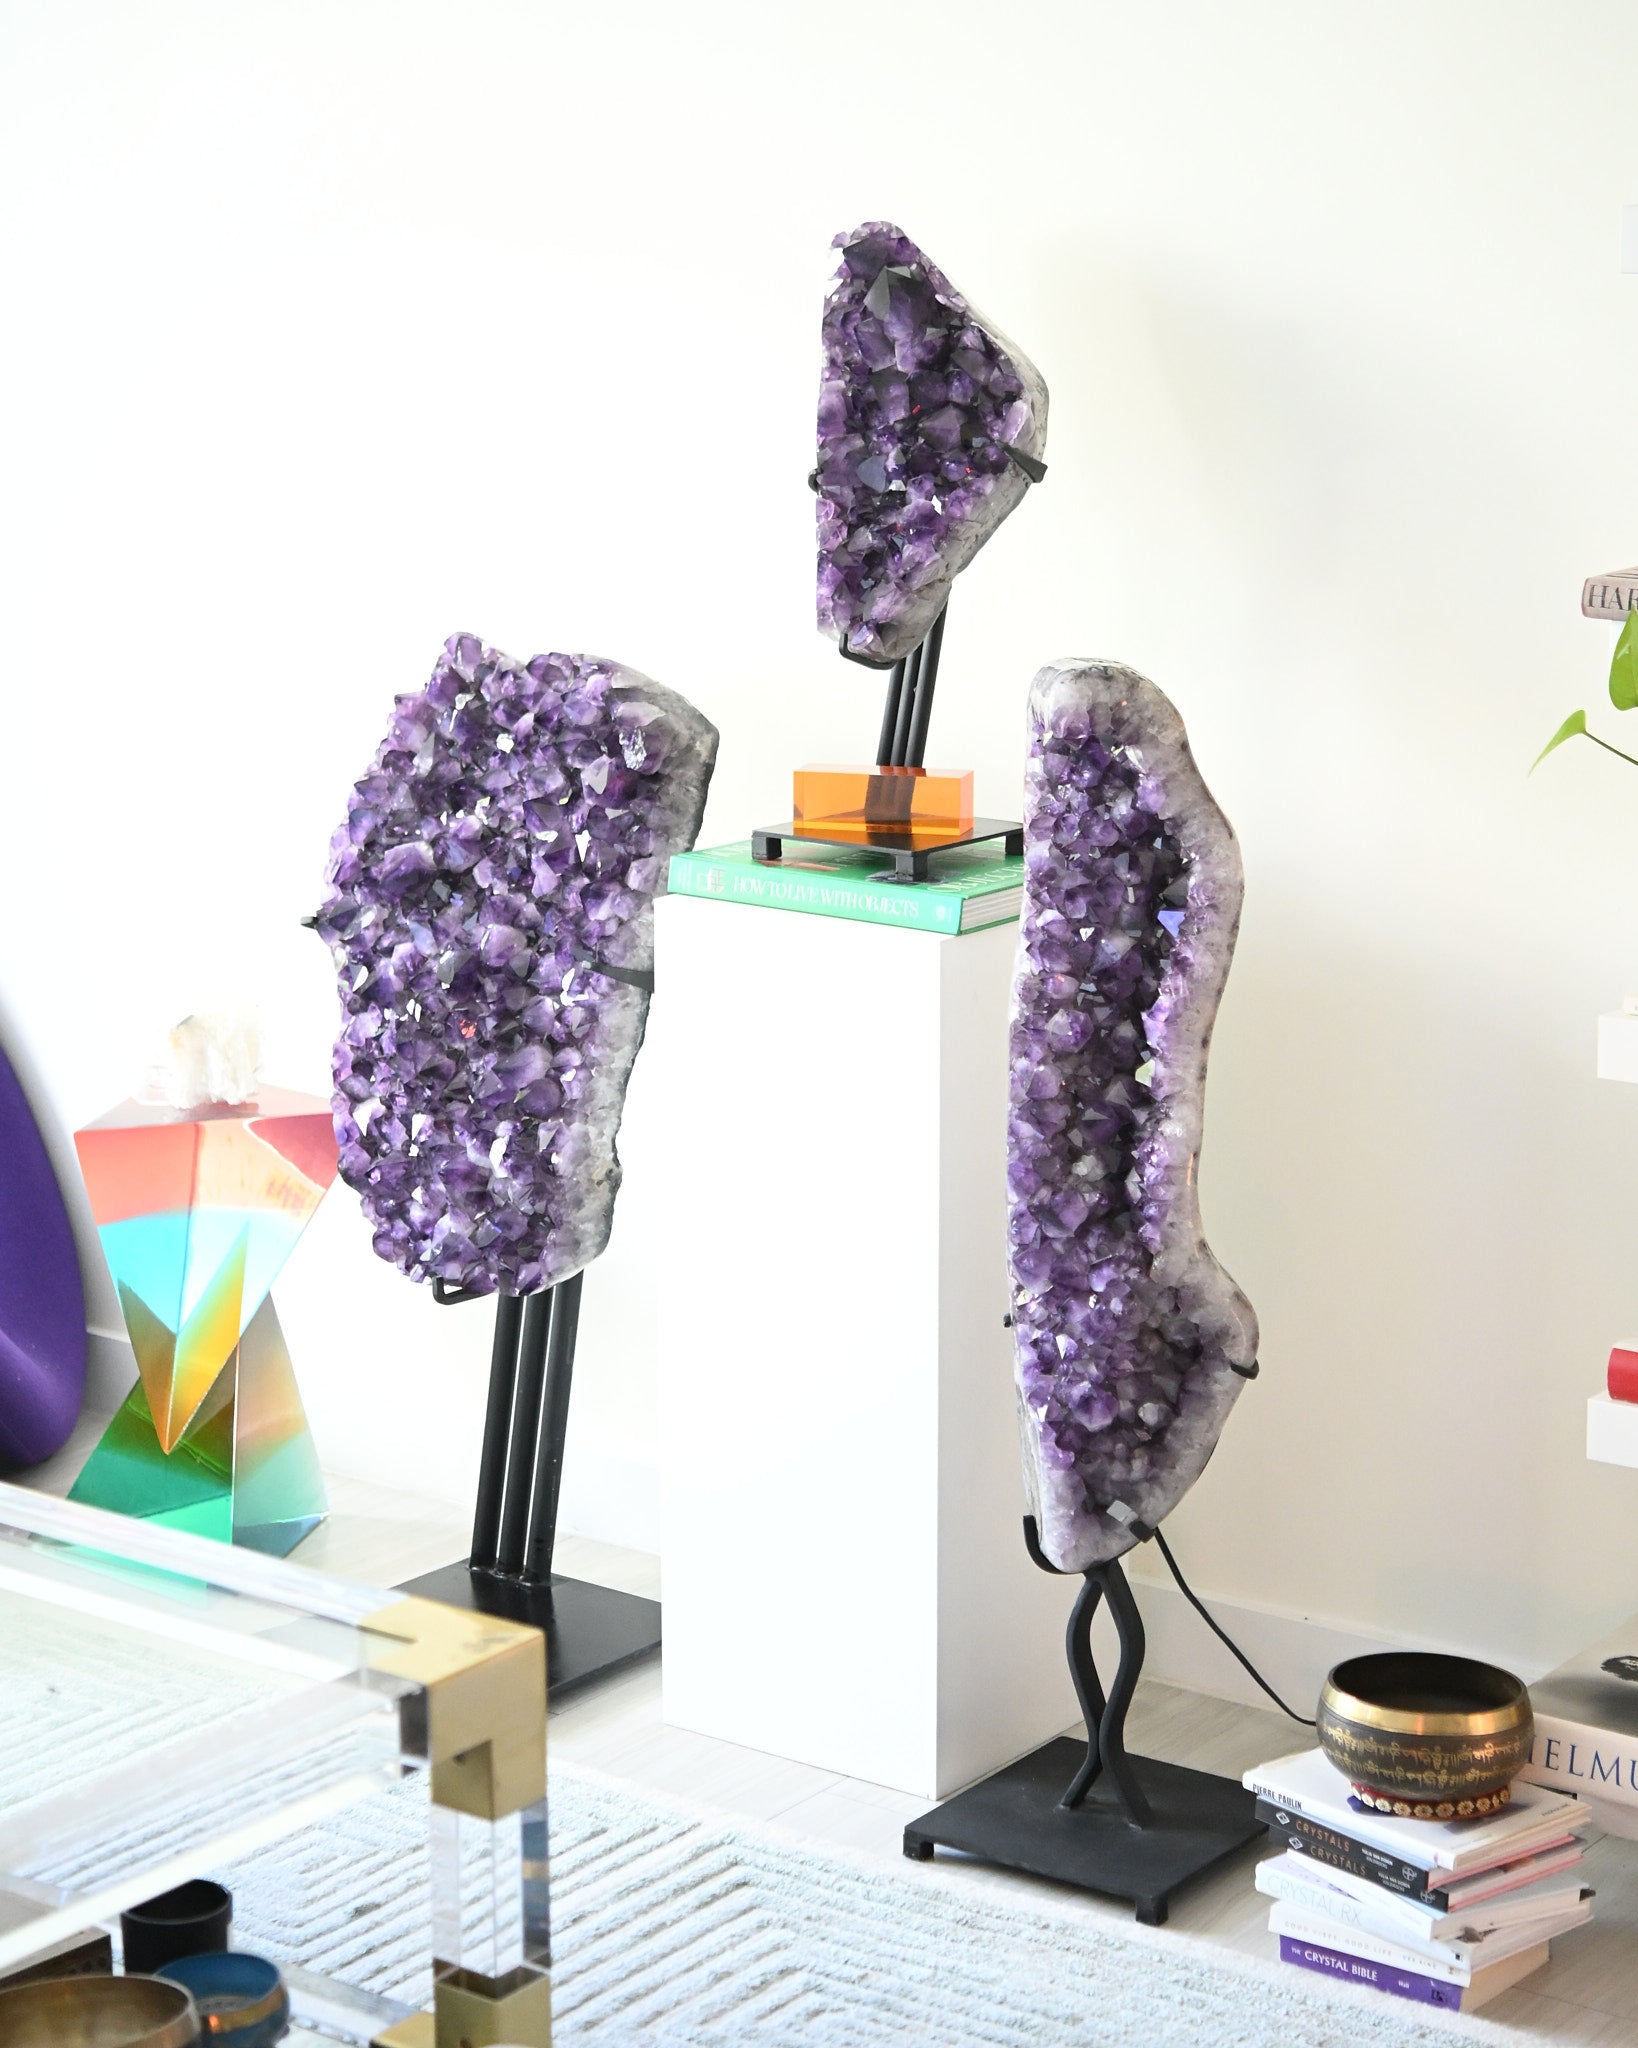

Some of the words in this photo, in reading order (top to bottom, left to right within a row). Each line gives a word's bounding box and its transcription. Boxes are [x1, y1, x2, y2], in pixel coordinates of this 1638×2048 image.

[733, 874, 766, 897] HOW
[767, 878, 787, 898] TO
[787, 882, 818, 905] LIVE
[819, 887, 858, 911] WITH
[857, 892, 919, 919] OBJECTS
[1252, 1783, 1276, 1800] PIERRE
[1277, 1793, 1303, 1811] PAULIN
[1295, 1820, 1350, 1853] CRYSTALS
[1309, 1845, 1367, 1877] CRYSTALS
[1267, 1874, 1337, 1918] CRYSTAL
[1340, 1902, 1363, 1927] RX
[1304, 1949, 1349, 1973] CRYSTAL
[1351, 1964, 1379, 1982] BIBLE
